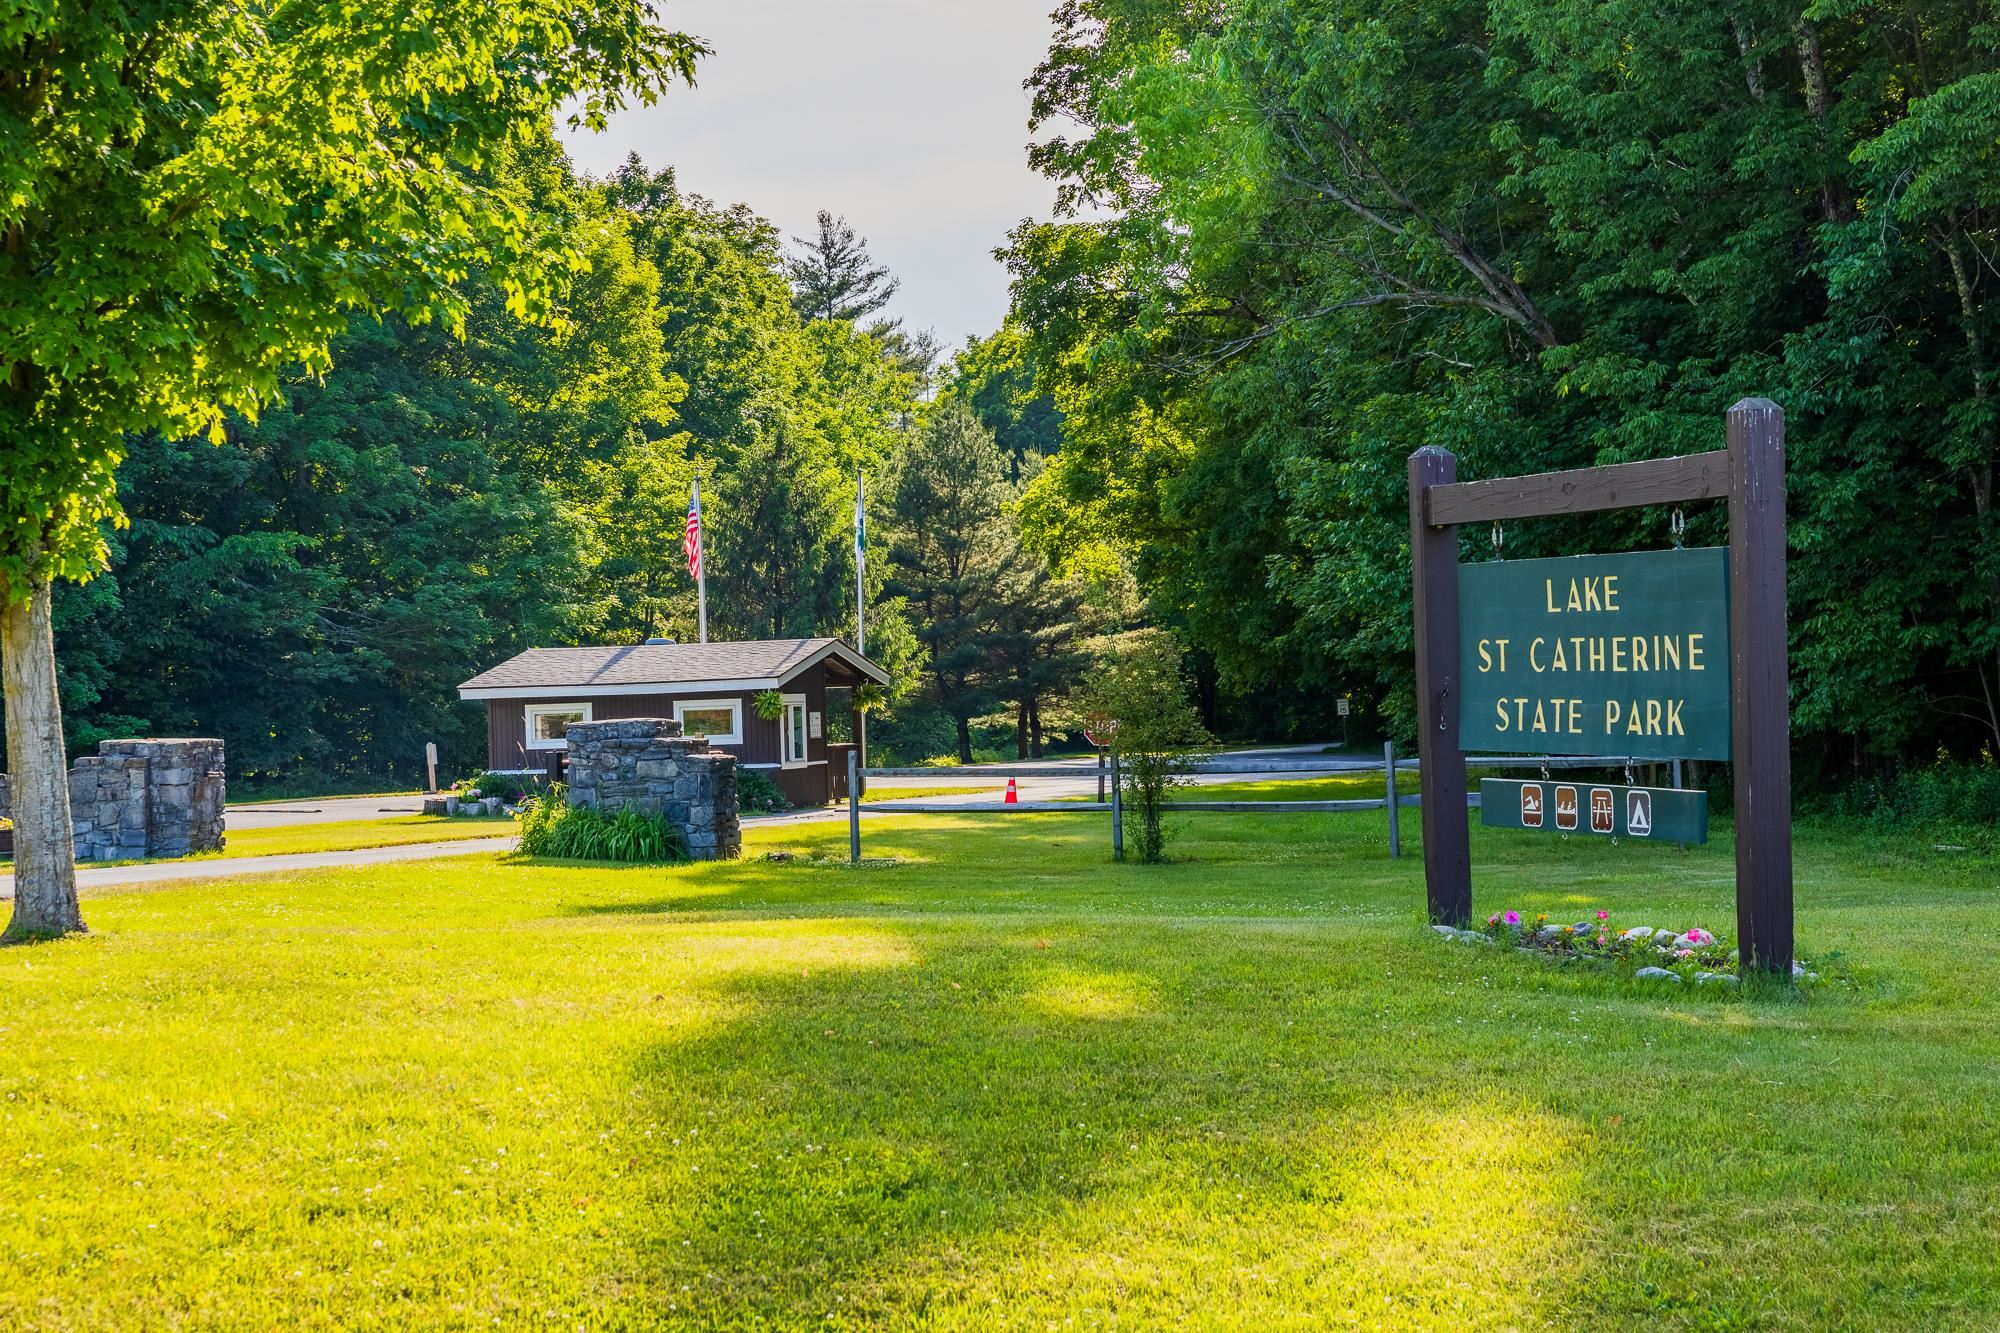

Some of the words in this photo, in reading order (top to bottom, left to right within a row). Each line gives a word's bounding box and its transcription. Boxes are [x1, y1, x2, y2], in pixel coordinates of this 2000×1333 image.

[1546, 576, 1620, 613] LAKE
[1478, 639, 1509, 673] ST
[1529, 633, 1705, 673] CATHERINE
[1495, 698, 1583, 734] STATE
[1606, 699, 1685, 736] PARK
